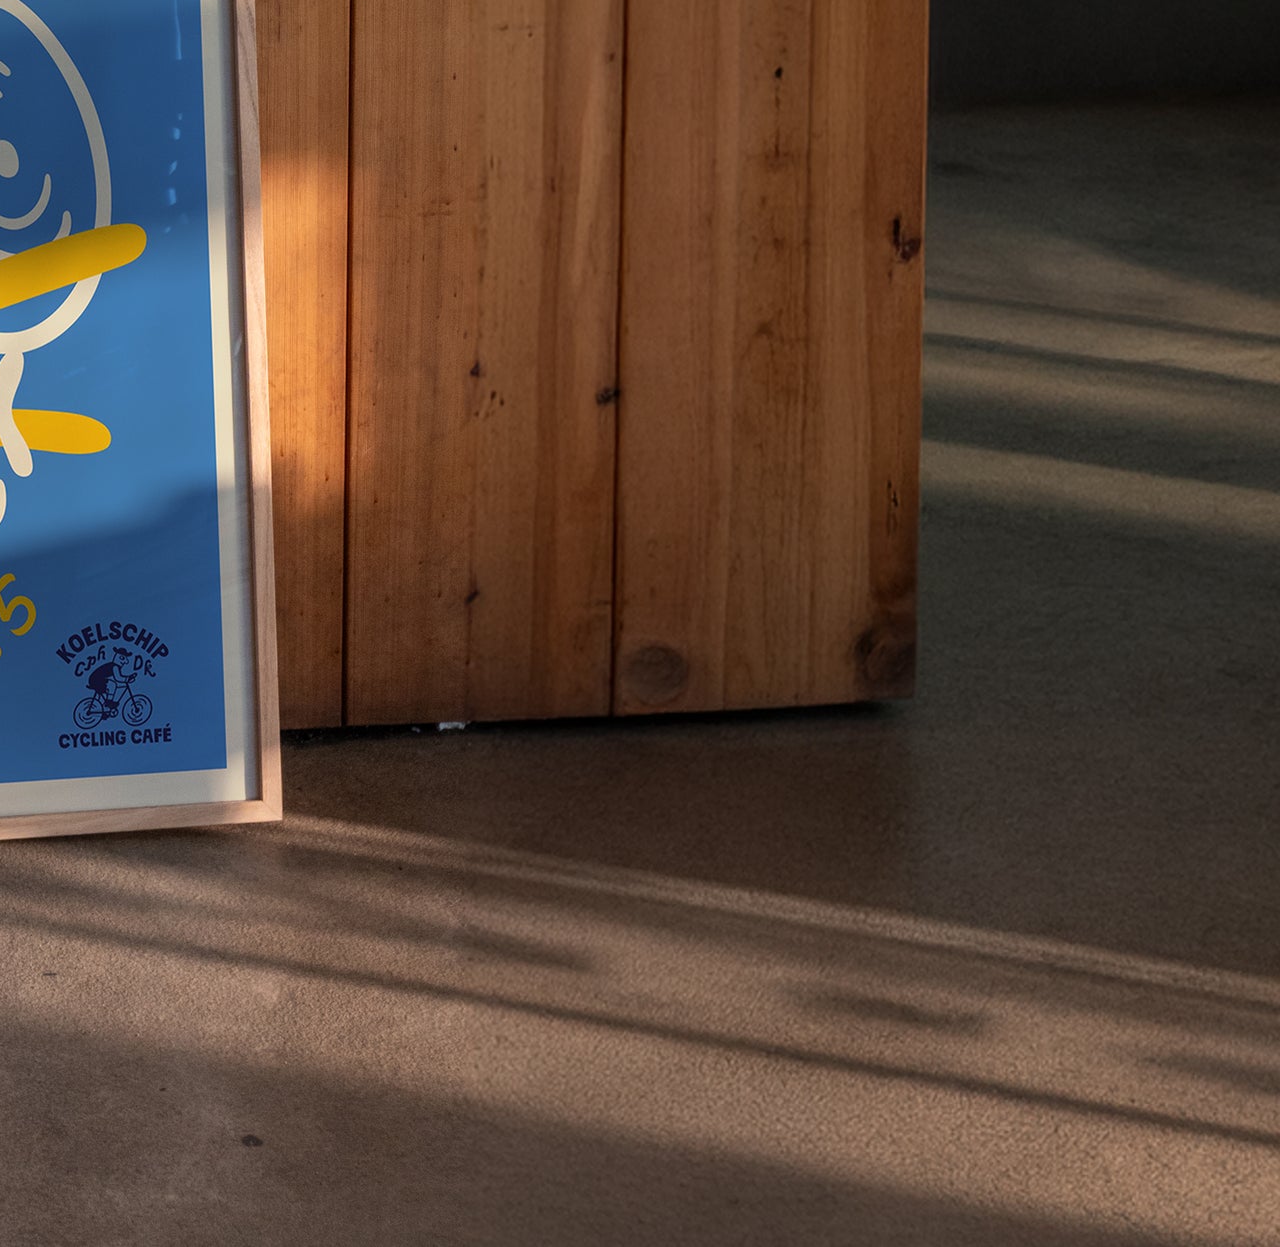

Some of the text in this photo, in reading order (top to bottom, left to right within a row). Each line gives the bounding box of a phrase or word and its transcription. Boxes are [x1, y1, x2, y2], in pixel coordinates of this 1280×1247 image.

[55, 621, 170, 665] KOELSCHIP
[58, 723, 172, 749] CYCLING CAFÉ
